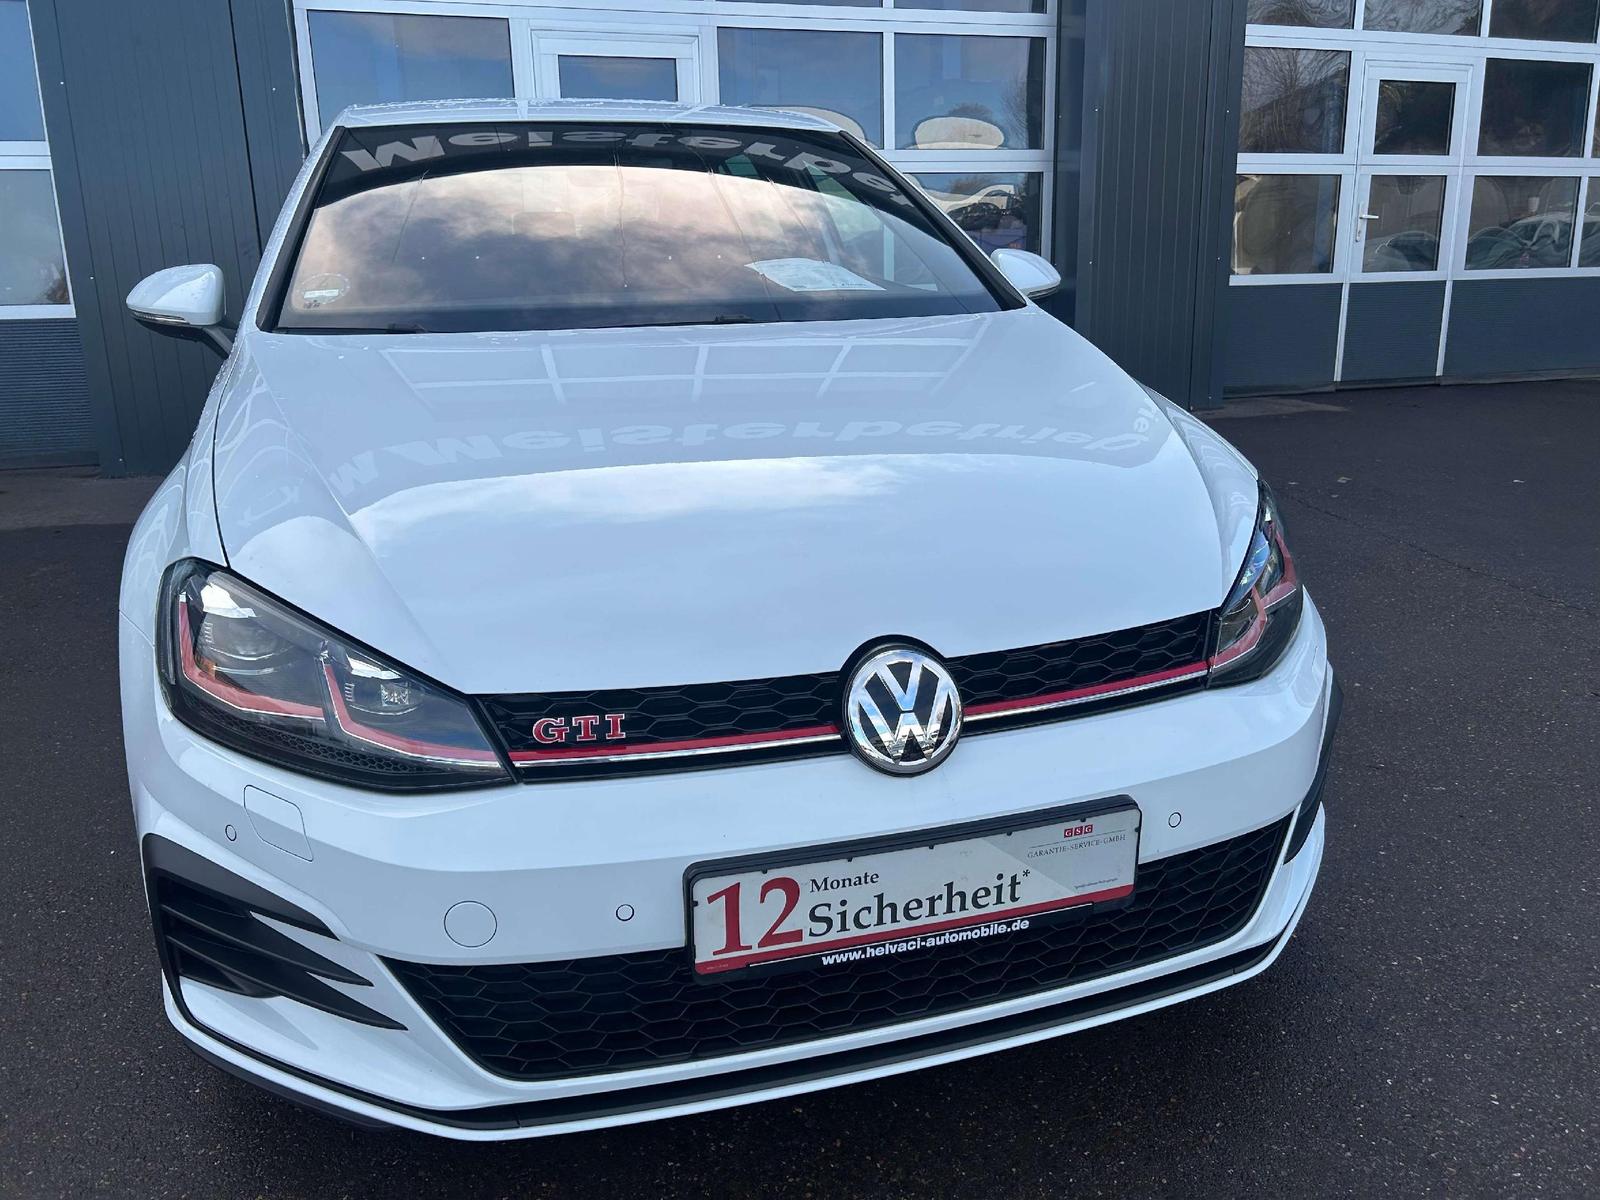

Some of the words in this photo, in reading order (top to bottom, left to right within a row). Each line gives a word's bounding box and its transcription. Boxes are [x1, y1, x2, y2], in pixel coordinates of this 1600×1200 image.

[532, 713, 627, 744] GTI
[1064, 824, 1094, 838] GSG
[810, 870, 880, 893] Monate
[706, 876, 804, 956] 12
[821, 918, 1030, 966] www.helvaci-automobile.de
